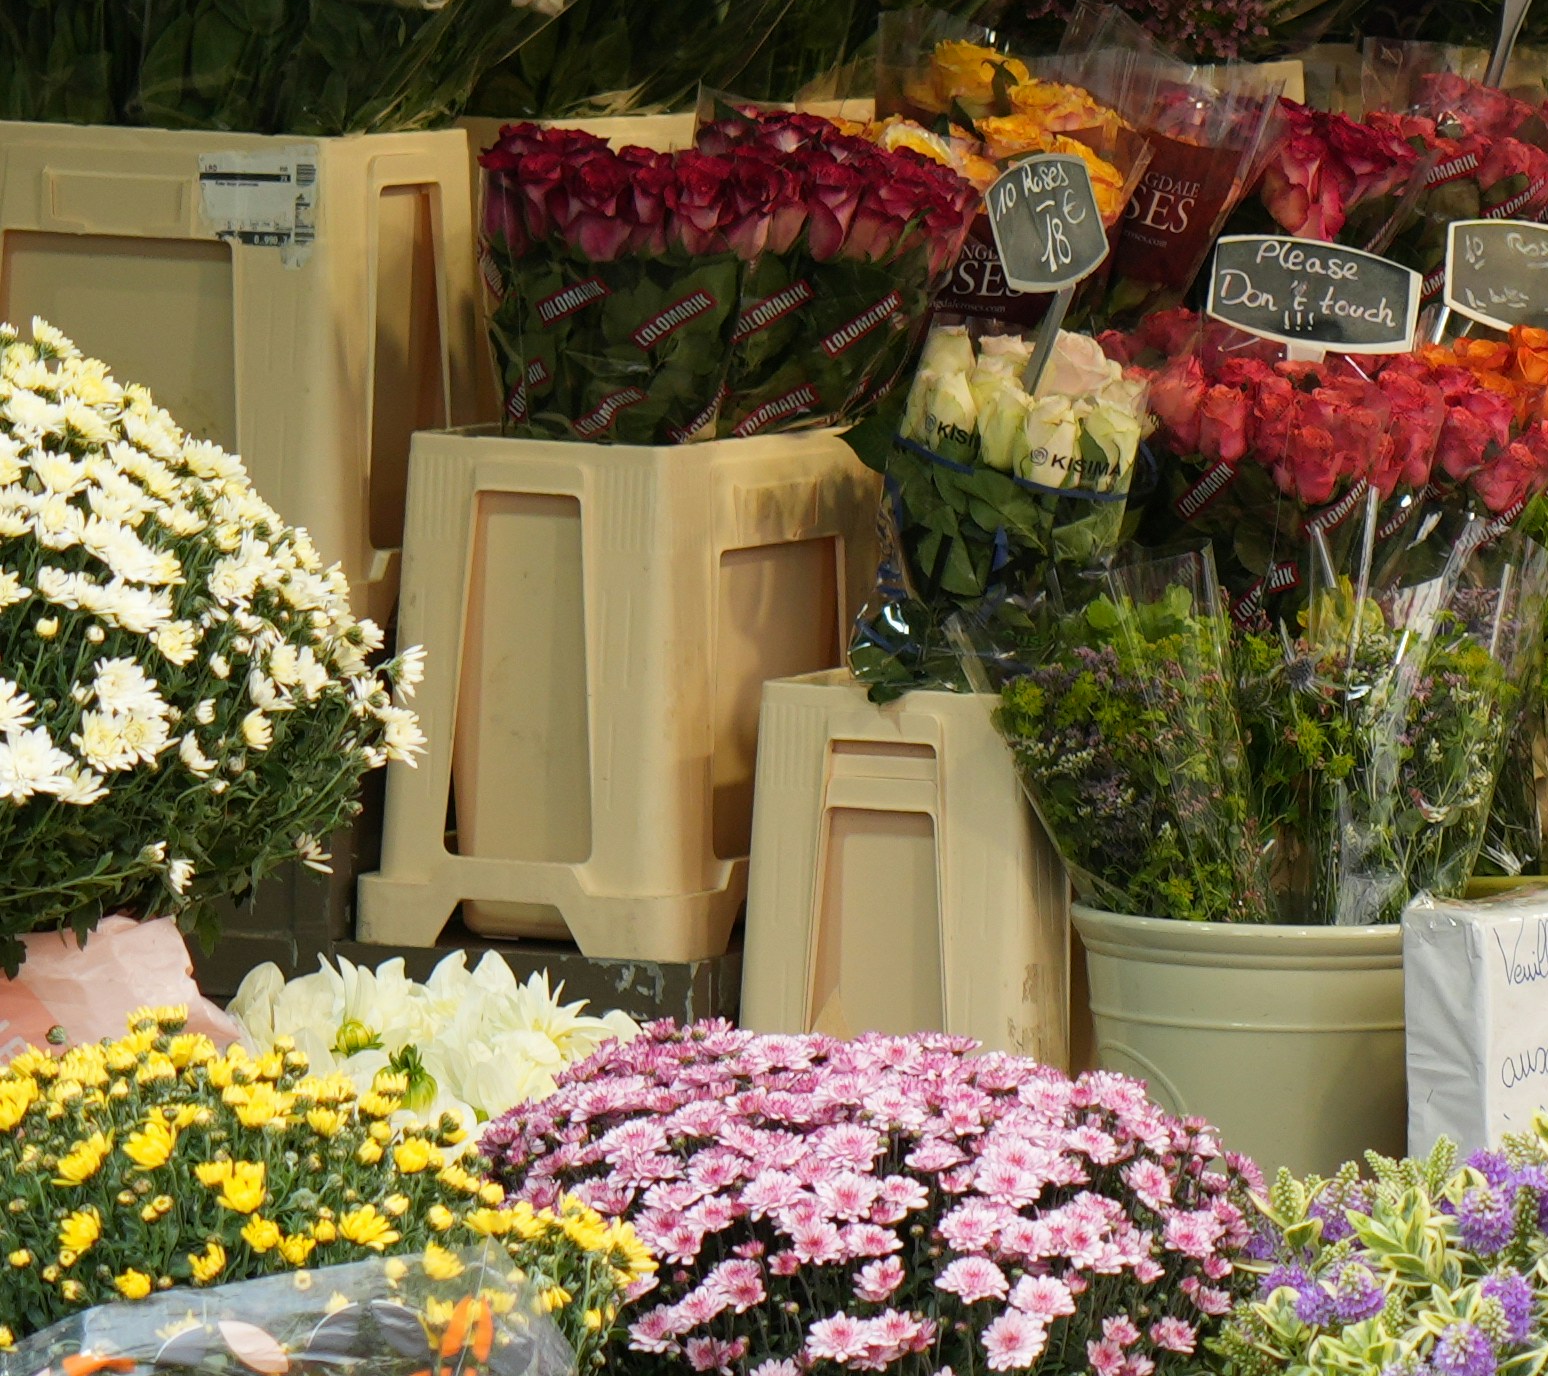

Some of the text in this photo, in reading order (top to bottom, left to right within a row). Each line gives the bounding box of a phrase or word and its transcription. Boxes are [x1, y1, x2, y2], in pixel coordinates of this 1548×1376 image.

[997, 161, 1069, 221] 10 Roses
[1144, 171, 1200, 199] GDALE
[1426, 153, 1479, 184] OMARIK
[1124, 184, 1196, 234] SES
[1256, 241, 1359, 281] Please
[538, 278, 606, 323] LOLOMARIK
[634, 293, 713, 347] LOLOMARIK
[733, 282, 810, 339] LOLOMARIK
[1219, 269, 1396, 327] Don't touch
[824, 293, 899, 354] LOLOMARIK
[575, 387, 643, 435] LOLOMARIK
[739, 388, 815, 436] LOLOMARIK
[1051, 453, 1121, 479] KISIMA
[1179, 461, 1235, 518] LOLOMARIK
